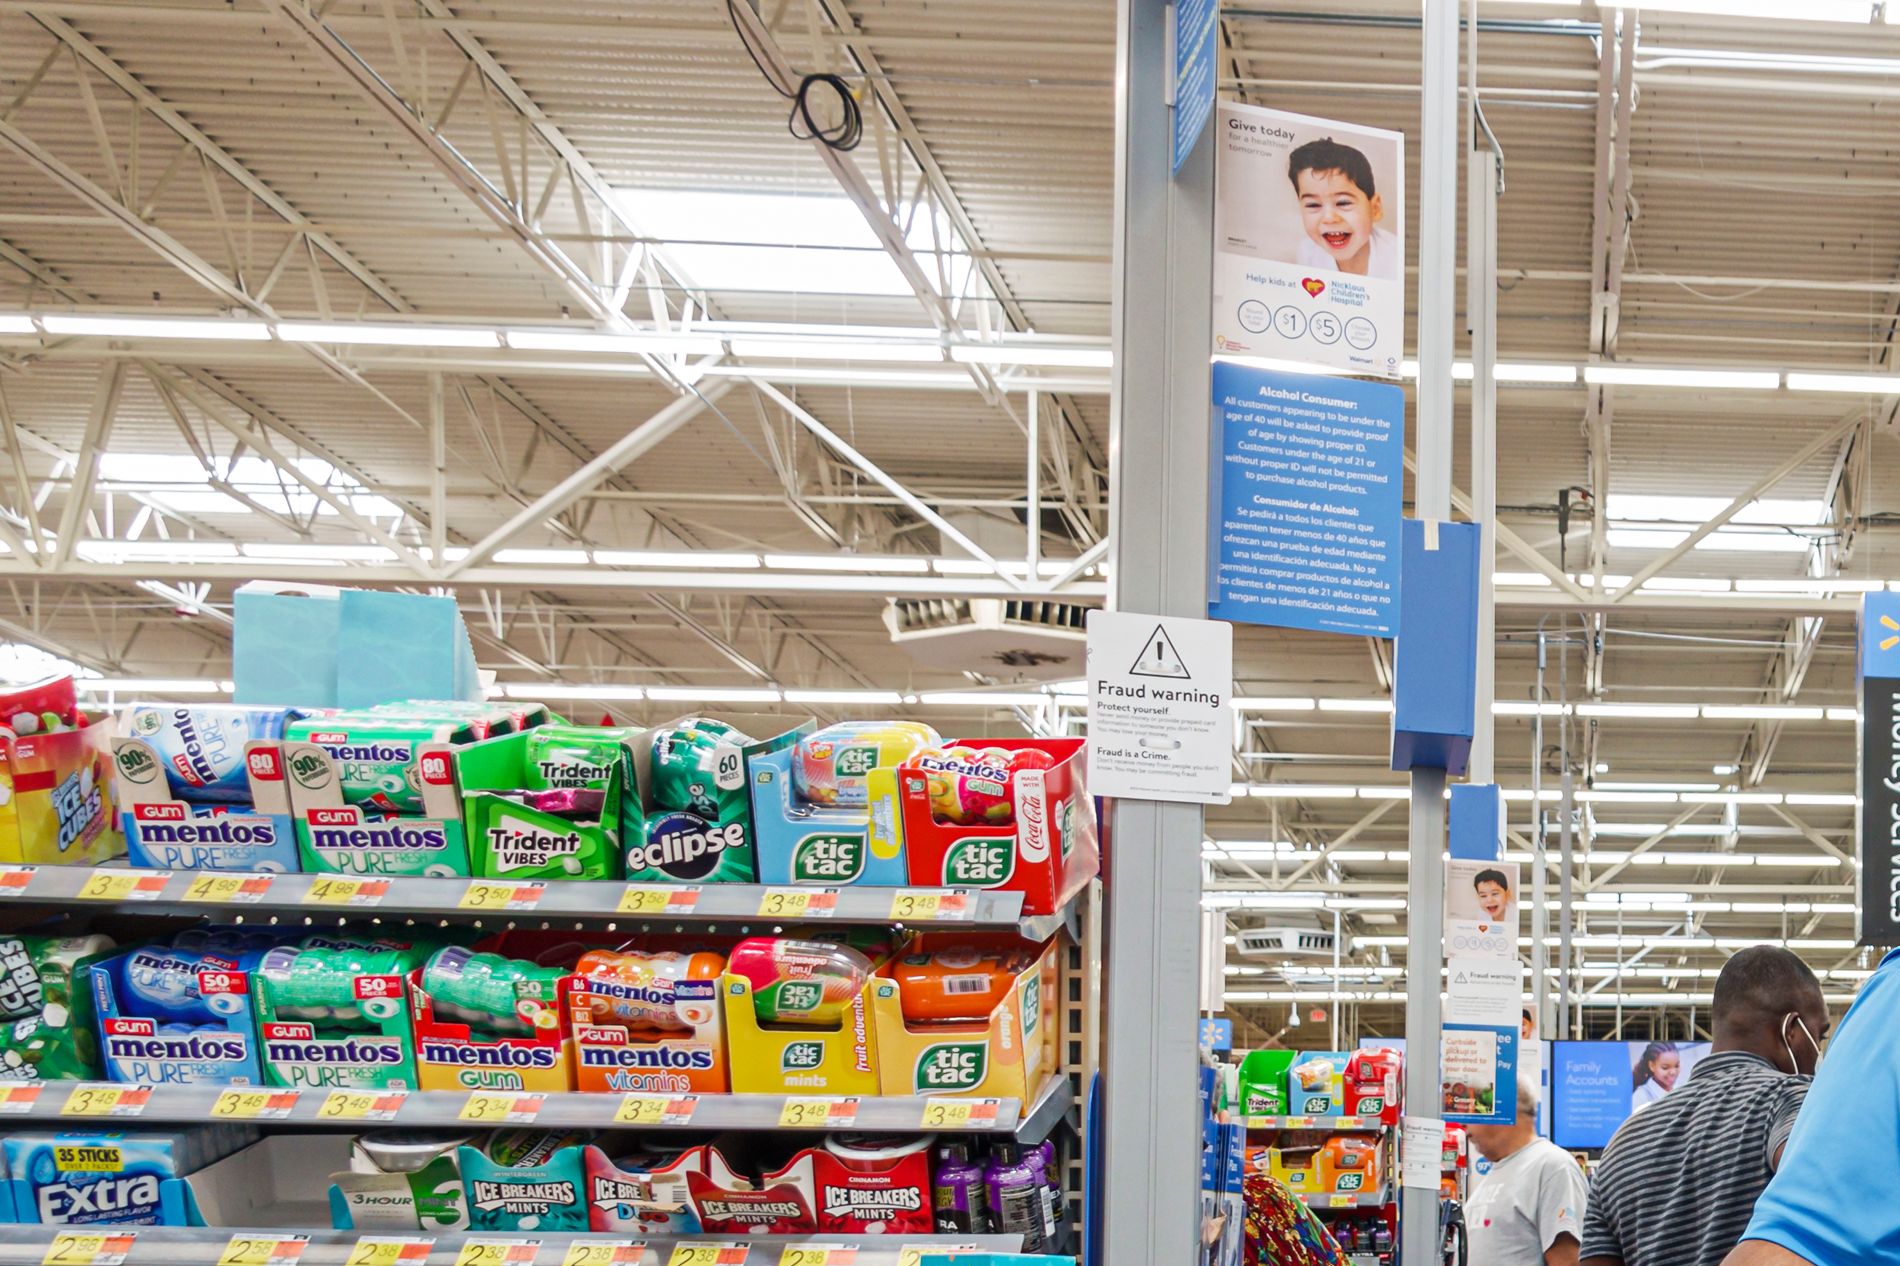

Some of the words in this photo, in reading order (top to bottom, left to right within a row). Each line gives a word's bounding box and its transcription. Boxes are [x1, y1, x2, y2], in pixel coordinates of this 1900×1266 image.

[1228, 118, 1256, 133] Give
[1261, 126, 1296, 142] today
[1229, 132, 1242, 141] for
[1252, 136, 1289, 149] healthier
[1228, 144, 1272, 158] tomorrow
[1246, 273, 1266, 286] Help
[1269, 276, 1286, 288] kids
[1288, 280, 1296, 288] at
[1331, 288, 1370, 301] Children's
[1331, 296, 1364, 308] Hospital
[1283, 314, 1296, 332] $1
[1316, 318, 1335, 338] $5
[1259, 386, 1300, 400] Alcohol
[1302, 393, 1358, 409] Consumer:
[1224, 396, 1236, 406] All
[1238, 399, 1282, 413] customers
[1283, 405, 1326, 421] appearing
[1327, 411, 1336, 420] to
[1338, 412, 1348, 422] be
[1351, 414, 1375, 427] under
[1376, 418, 1390, 429] the
[1226, 413, 1242, 422] age
[1244, 412, 1253, 422] of
[1255, 414, 1265, 424] 40
[1267, 416, 1282, 426] will
[1283, 418, 1294, 428] be
[1296, 420, 1320, 432] asked
[1322, 424, 1331, 434] to
[1332, 426, 1364, 438] provide
[1366, 430, 1388, 442] proof
[1253, 495, 1308, 509] Consumidor
[1310, 500, 1320, 512] de
[1322, 502, 1360, 517] Alcohol:
[1098, 680, 1146, 698] Fraud
[1152, 688, 1220, 708] warning
[1097, 702, 1130, 712] Protect
[1097, 747, 1122, 757] Fraud
[1125, 749, 1132, 758] is
[719, 754, 738, 774] 60
[922, 758, 1008, 782] mentos
[1021, 794, 1044, 850] Coca-Cola
[142, 821, 274, 844] mentos
[490, 829, 580, 851] Trident
[628, 824, 744, 870] eclipse
[814, 838, 854, 860] tic
[965, 843, 1004, 864] tic
[166, 847, 222, 868] PURE
[503, 853, 548, 866] VIBES
[805, 858, 854, 875] tac
[956, 863, 1003, 879] tac
[204, 974, 229, 987] 50
[110, 1038, 244, 1060] mentos
[268, 1043, 402, 1063] mentos
[425, 1044, 554, 1066] mentos
[583, 1048, 712, 1068] mentos
[936, 1048, 976, 1068] tic
[927, 1066, 974, 1084] tac
[1566, 1061, 1602, 1074] Family
[606, 1070, 690, 1092] vitamins
[784, 1075, 828, 1088] mints
[1566, 1074, 1618, 1086] Accounts
[59, 1148, 75, 1162] 35
[78, 1148, 120, 1163] STICKS
[848, 1176, 890, 1184] CINNAMON
[40, 1175, 160, 1224] Extra
[474, 1181, 499, 1200] ICE
[500, 1181, 574, 1203] BREAKERS
[825, 1186, 848, 1206] ICE
[850, 1186, 920, 1209] BREAKERS
[506, 1202, 549, 1214] MINTS
[854, 1208, 895, 1220] MINTS
